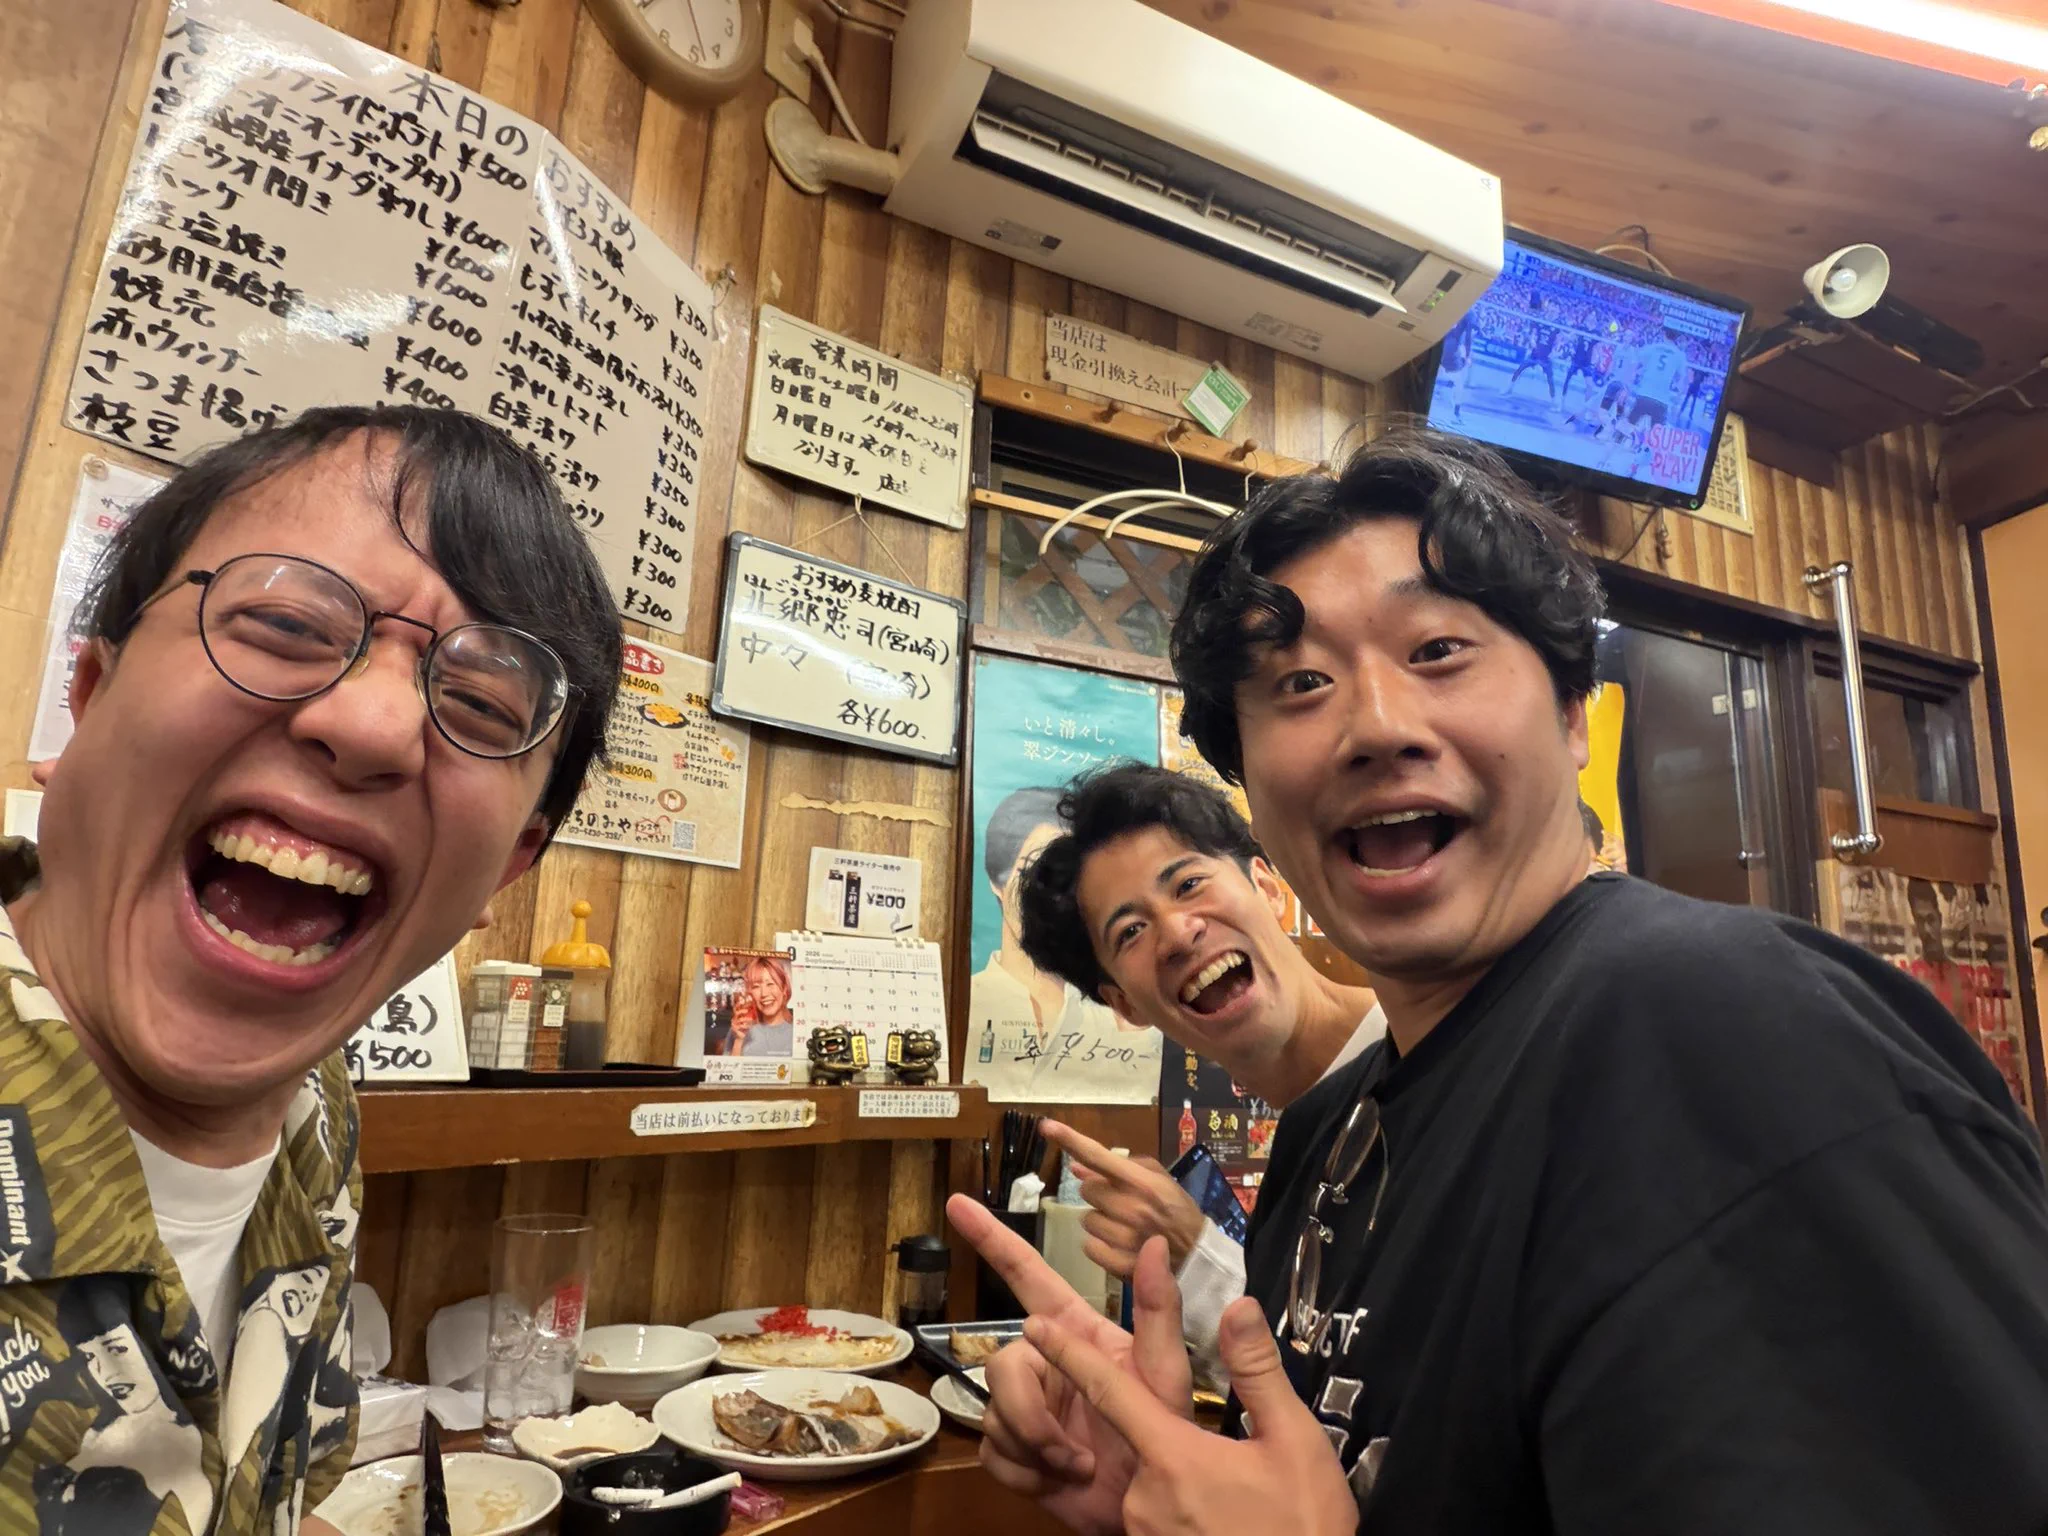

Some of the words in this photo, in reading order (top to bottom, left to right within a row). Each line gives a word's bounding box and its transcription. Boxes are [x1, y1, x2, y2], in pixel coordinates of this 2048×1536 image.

[162, 52, 462, 203] (ーオニオンディップ付)
[457, 142, 528, 191] ¥500
[441, 211, 510, 254] ¥600
[130, 200, 287, 270] 塩焼き
[407, 295, 483, 346] ¥600
[424, 236, 496, 282] ¥600
[414, 262, 488, 308] ¥600
[528, 226, 660, 332] マカニツナサラダ
[670, 329, 703, 371] ¥350
[519, 263, 620, 341] もずくキムチ
[663, 356, 698, 398] ¥350
[674, 293, 708, 337] ¥350
[109, 266, 216, 328] 焼売
[382, 366, 456, 410] ¥400
[396, 336, 469, 381] ¥400
[1052, 320, 1107, 354] 当店は
[810, 338, 899, 391] 営業時間
[771, 375, 832, 409] 日曜日
[74, 393, 181, 452] 枝豆
[495, 361, 609, 436] 冷やしトマト
[658, 448, 694, 485] ¥350
[672, 400, 704, 438] ¥350
[1651, 423, 1701, 457] SUPER
[662, 425, 698, 462] ¥350
[651, 471, 690, 507] ¥350
[1650, 456, 1699, 484] PLAY!
[644, 496, 686, 533] ¥300
[638, 529, 683, 563] ¥300
[632, 555, 677, 590] ¥300
[792, 563, 921, 619] おすすめ麦焼酎
[623, 586, 673, 622] ¥300
[741, 631, 809, 672] 中々
[1024, 715, 1116, 746] いと清々し。
[866, 891, 906, 909] ¥200
[1000, 1040, 1023, 1050] SUI
[0, 1360, 50, 1408] you
